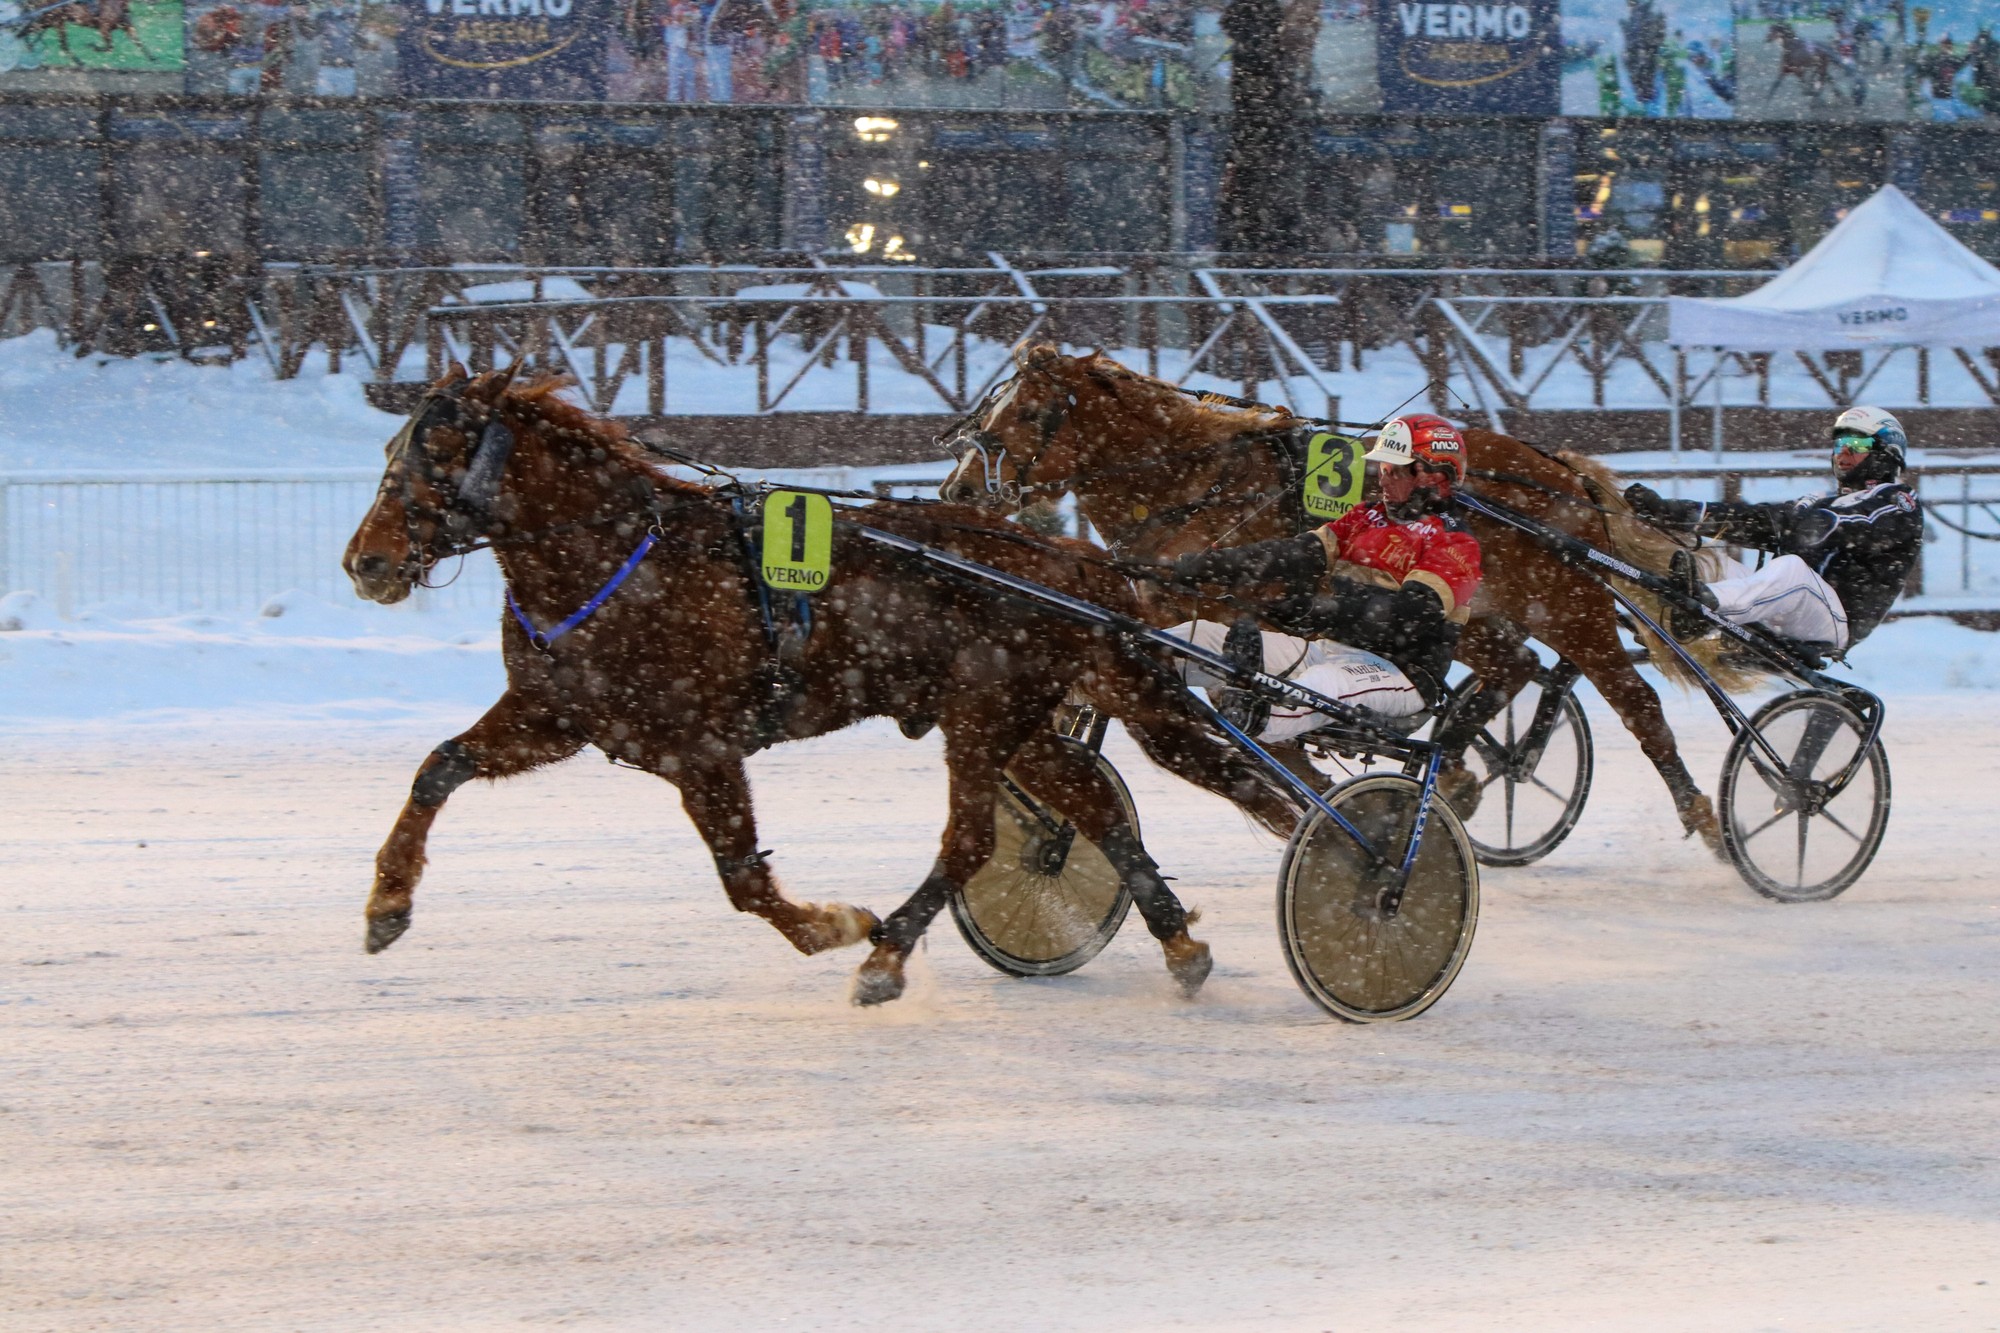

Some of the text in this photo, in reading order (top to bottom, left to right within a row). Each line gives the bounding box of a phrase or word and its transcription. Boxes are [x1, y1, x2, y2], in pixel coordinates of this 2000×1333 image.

[1398, 3, 1532, 38] VERMO
[1836, 306, 1908, 325] VERMO
[1317, 438, 1354, 498] 3
[1306, 495, 1354, 514] VERMO
[785, 495, 807, 563] 1
[765, 566, 824, 586] VERMO
[1588, 548, 1641, 580] MIKKONEN
[1253, 671, 1315, 705] ROYAL
